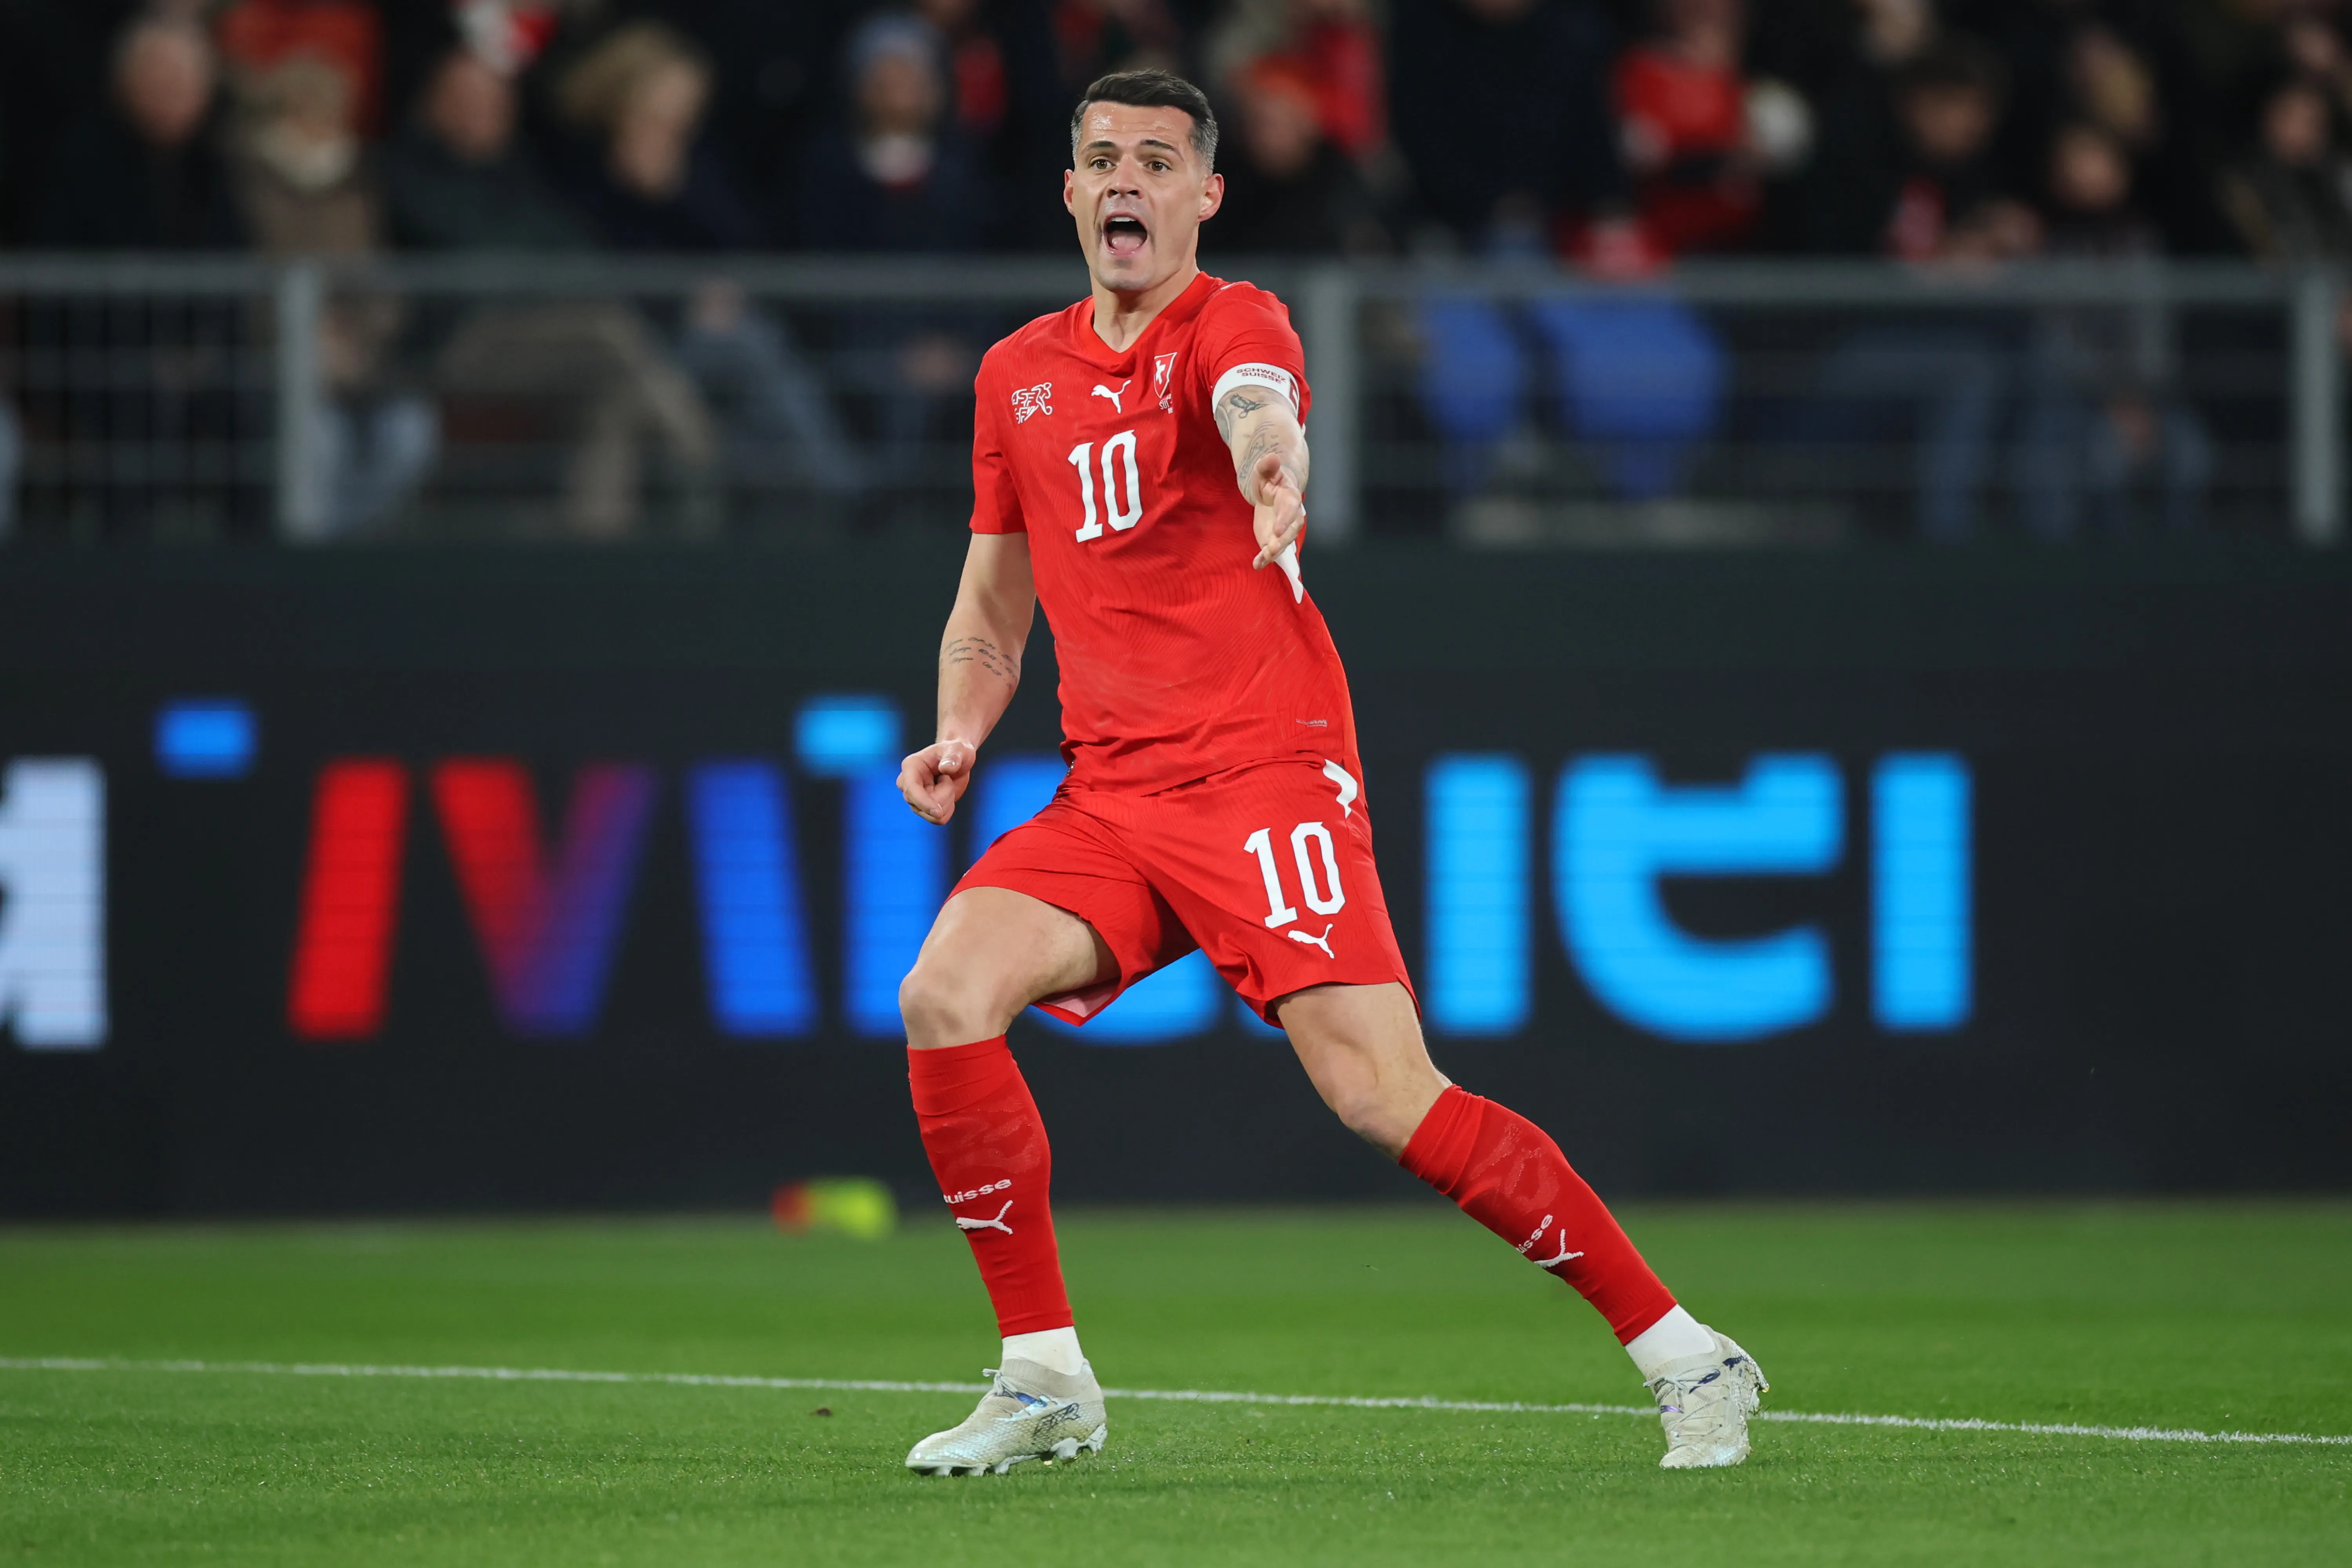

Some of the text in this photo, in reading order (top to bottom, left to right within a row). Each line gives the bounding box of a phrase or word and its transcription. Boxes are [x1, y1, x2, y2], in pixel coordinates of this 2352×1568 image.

[1237, 368, 1287, 383] SCHWEIZ
[1242, 372, 1281, 384] SUISSE
[1067, 429, 1143, 543] 10
[1243, 821, 1346, 929] 10
